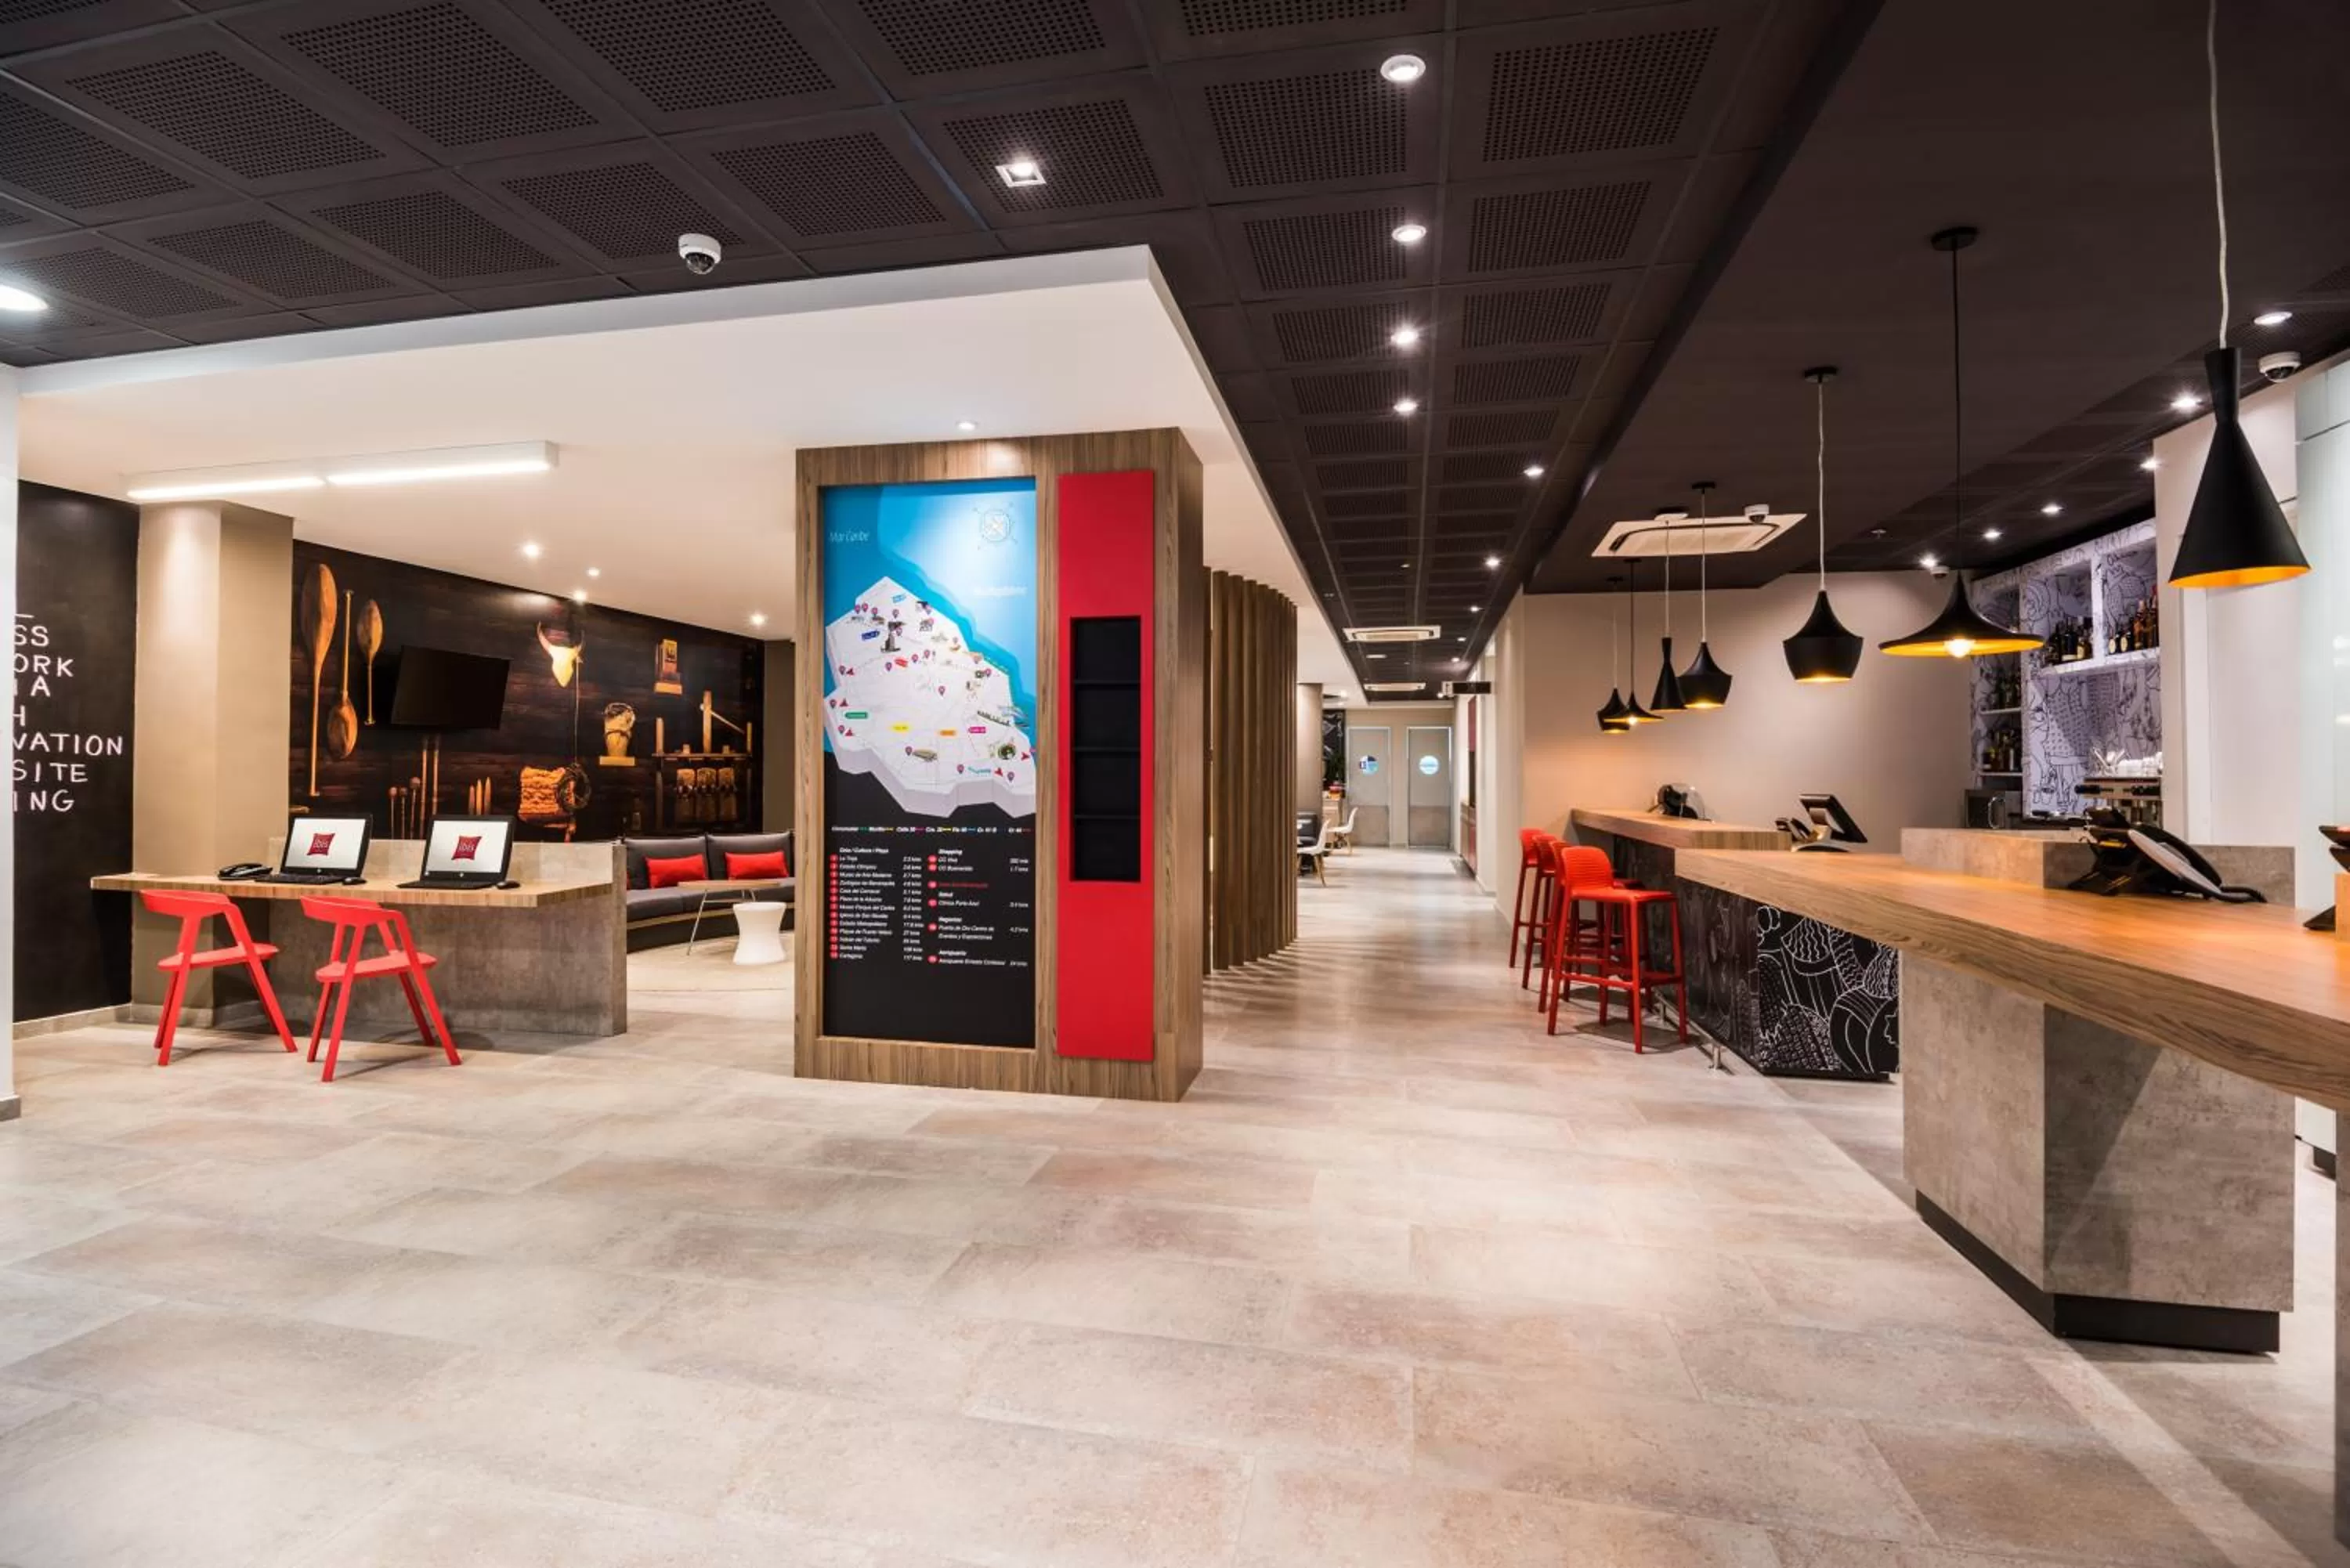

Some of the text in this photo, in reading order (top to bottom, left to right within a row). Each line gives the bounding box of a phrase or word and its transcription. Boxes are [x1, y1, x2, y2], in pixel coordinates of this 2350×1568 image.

[14, 625, 49, 647] SS
[13, 652, 74, 677] ORK
[13, 705, 26, 727] H
[13, 732, 123, 756] VATION
[13, 759, 89, 783] SITE
[13, 789, 75, 812] ING
